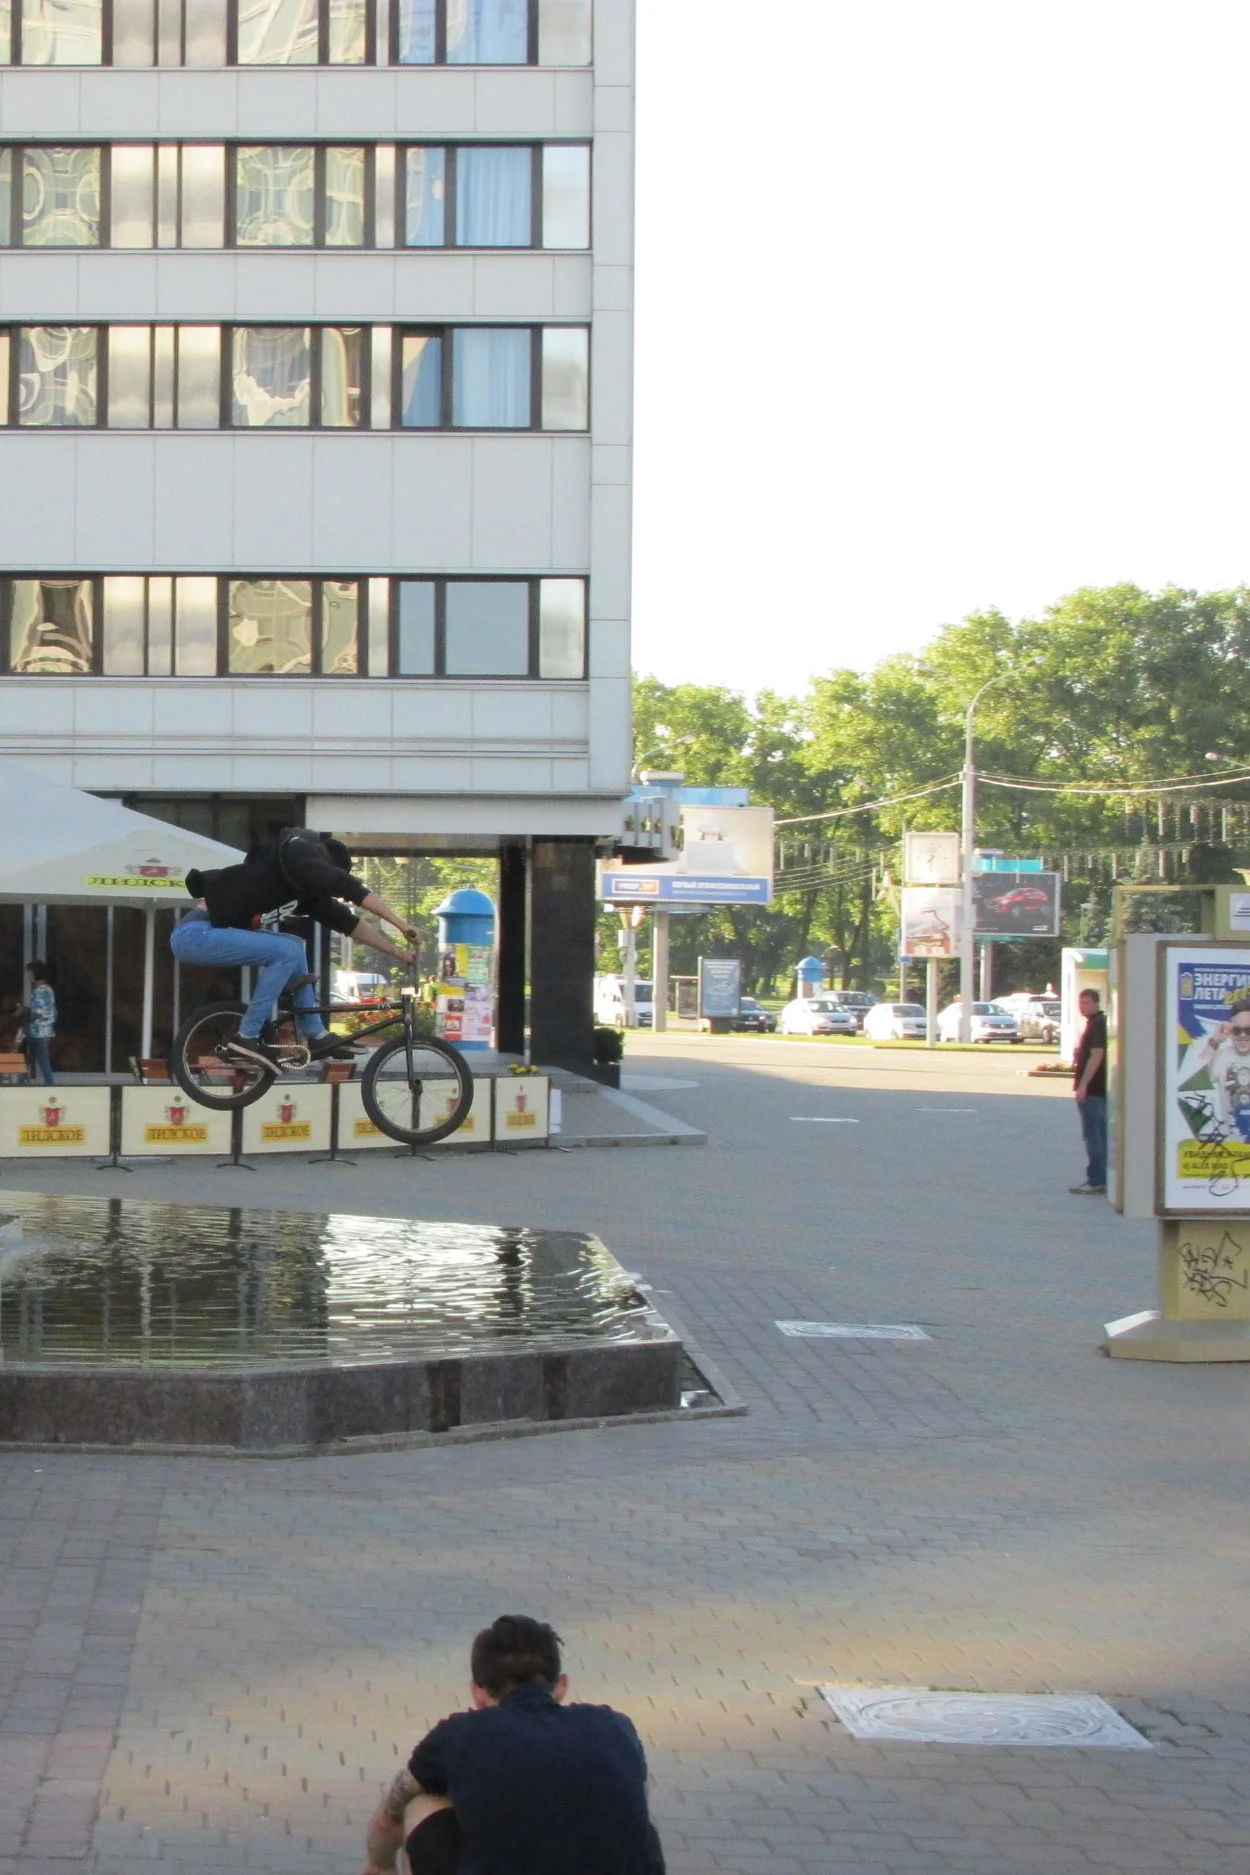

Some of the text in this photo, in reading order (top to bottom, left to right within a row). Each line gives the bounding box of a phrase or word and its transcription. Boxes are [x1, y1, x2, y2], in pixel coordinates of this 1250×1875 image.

[89, 877, 186, 889] ЛИДСК
[1193, 972, 1250, 987] ЭНЕРГИ
[1193, 987, 1226, 1001] ЛЕТА
[21, 1129, 84, 1142] ЛИДСКОЕ
[146, 1127, 206, 1140] ЛИДСКОЕ
